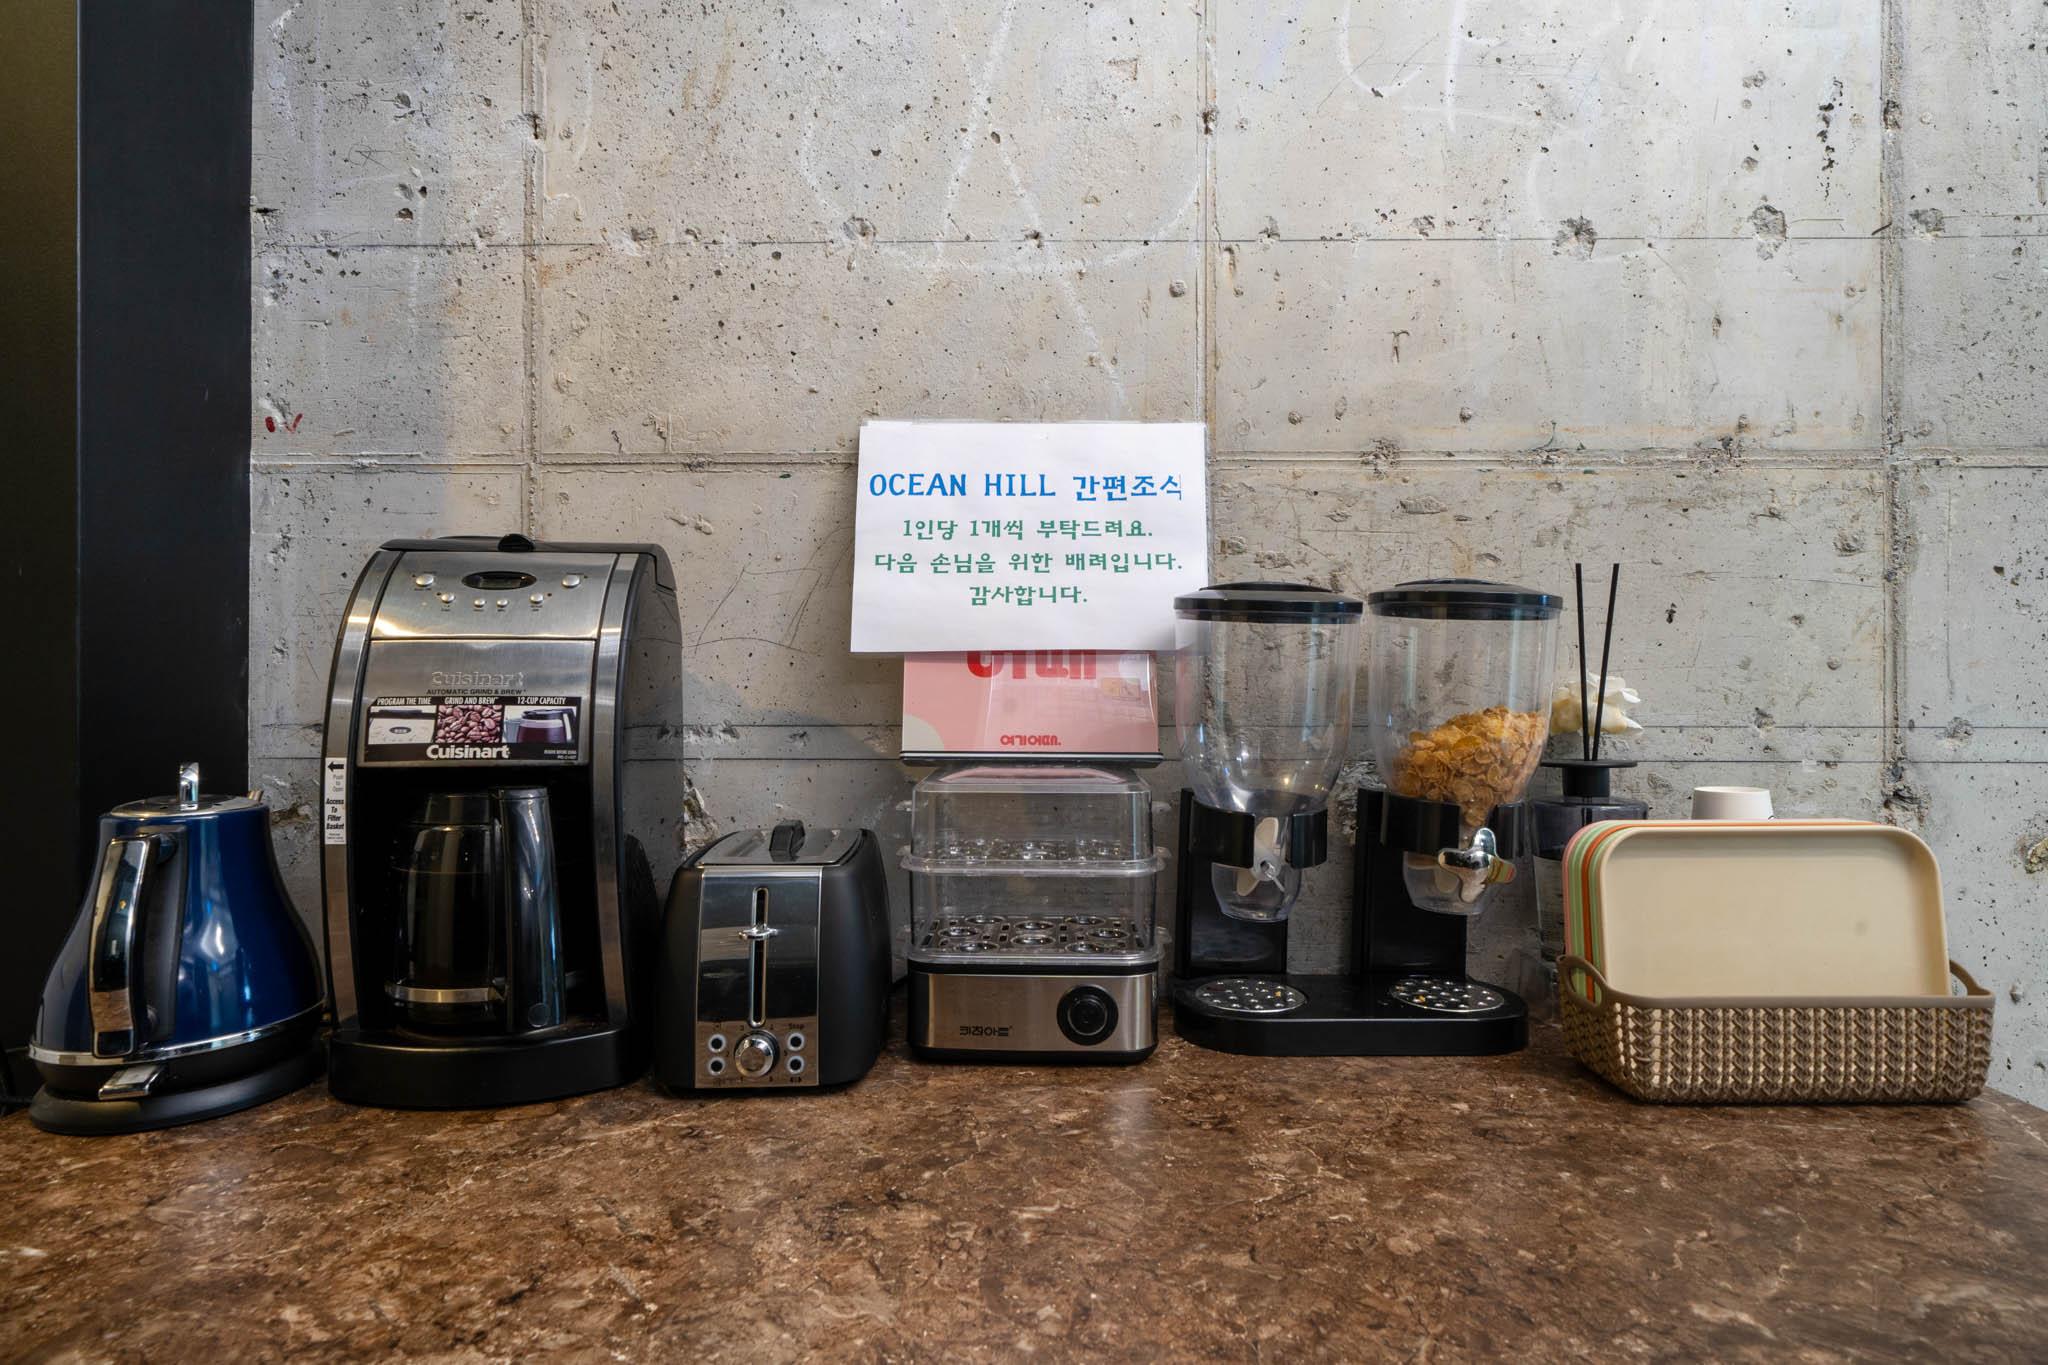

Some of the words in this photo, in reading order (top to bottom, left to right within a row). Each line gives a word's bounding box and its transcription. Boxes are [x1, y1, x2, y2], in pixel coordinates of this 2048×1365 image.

[869, 473, 967, 497] OCEAN
[985, 473, 1056, 497] HILL
[1073, 474, 1182, 502] 간편조식
[902, 520, 957, 541] 1인당
[969, 520, 1023, 541] 1개씩
[1037, 520, 1153, 540] 부탁드려요.
[874, 553, 918, 574] 다음
[930, 553, 996, 574] 손님을
[1009, 553, 1053, 574] 위한
[1065, 553, 1183, 574] 배려입니다.
[969, 586, 1088, 606] 감사합니다.
[431, 671, 525, 688] Cuisinart
[377, 697, 405, 705] PROGRAM
[406, 697, 417, 705] THE
[418, 697, 432, 705] TIME
[444, 696, 463, 705] GRIND
[464, 696, 477, 705] AND
[517, 696, 538, 705] 12-CUP
[539, 696, 566, 705] CAPACITY
[426, 744, 510, 760] Cuisinart
[326, 822, 344, 830] Basket
